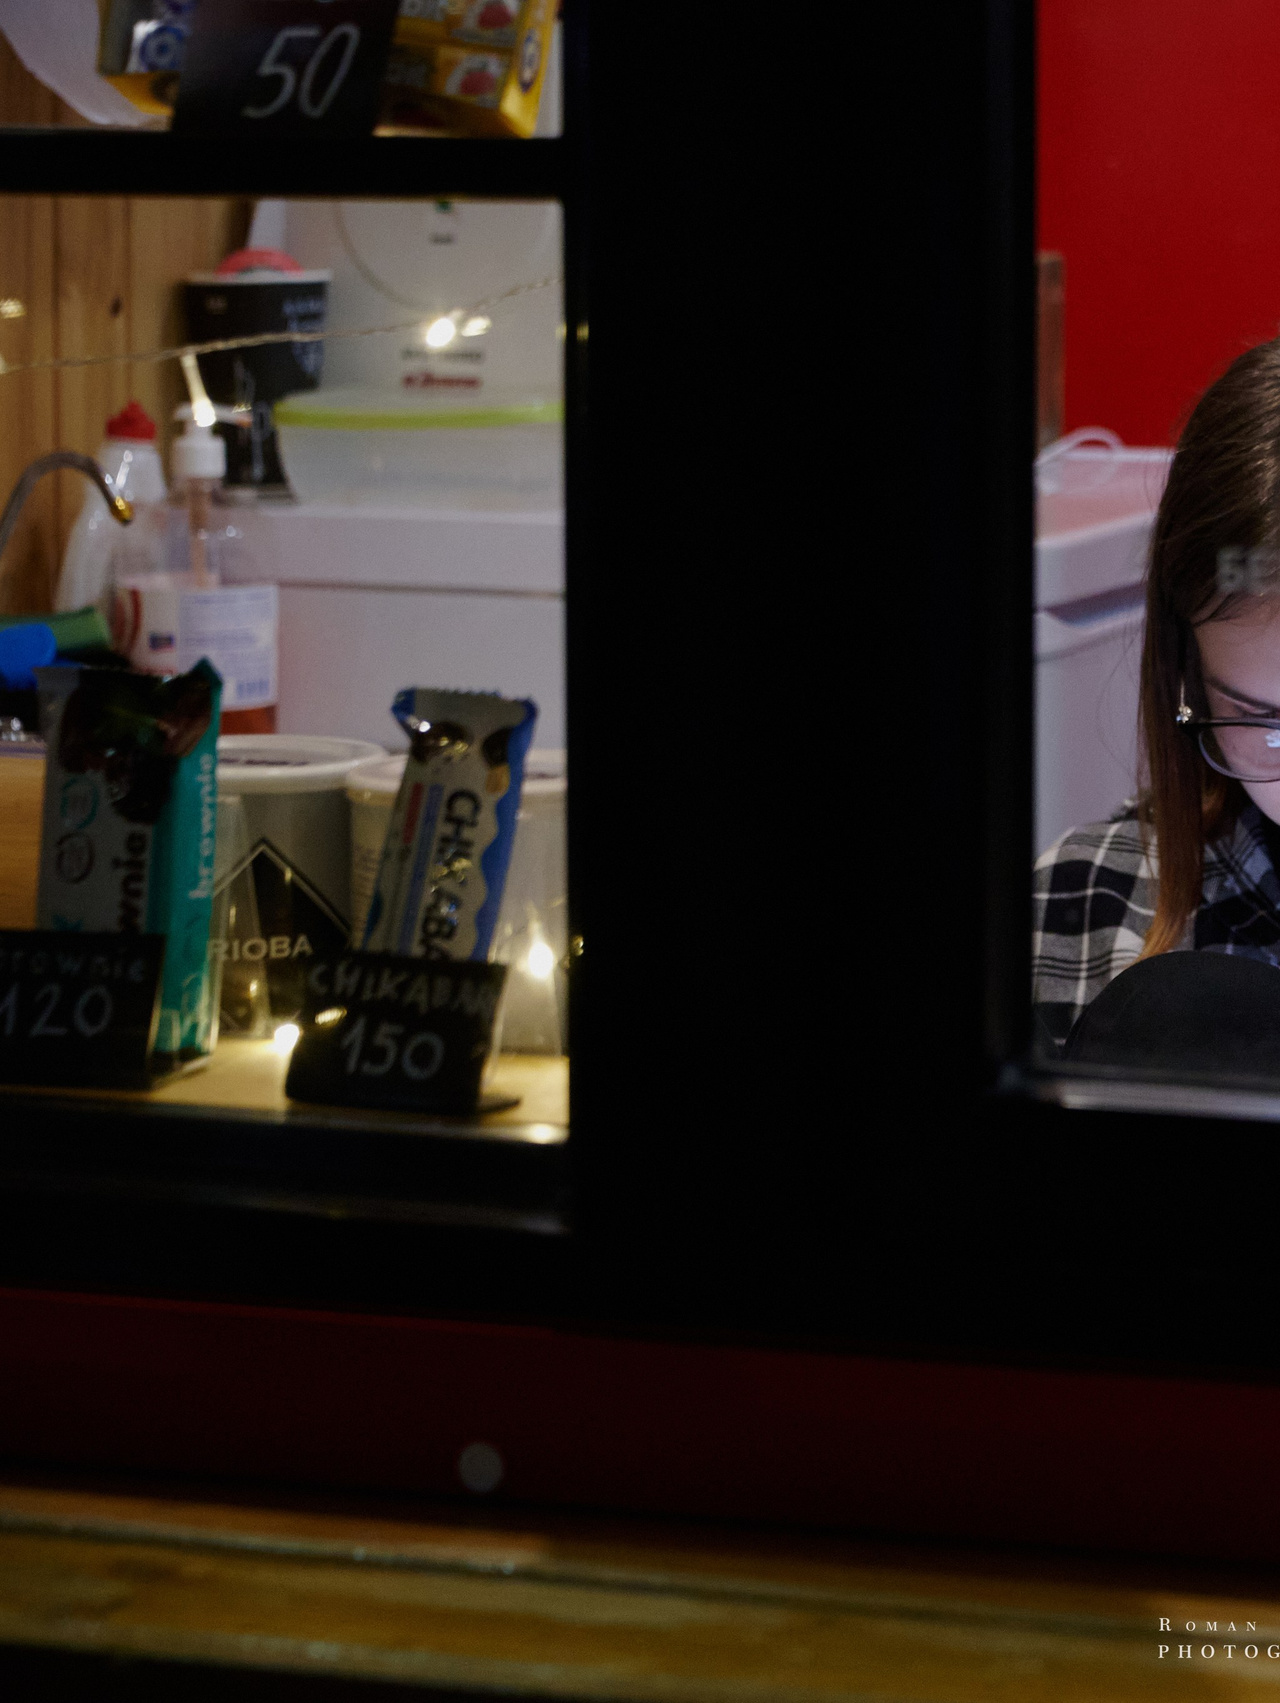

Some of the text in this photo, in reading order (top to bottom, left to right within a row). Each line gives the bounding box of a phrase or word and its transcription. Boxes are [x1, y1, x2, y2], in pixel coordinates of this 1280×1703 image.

[241, 23, 361, 118] 50
[0, 946, 145, 983] rownie
[0, 981, 113, 1038] 120
[340, 1013, 445, 1080] 150
